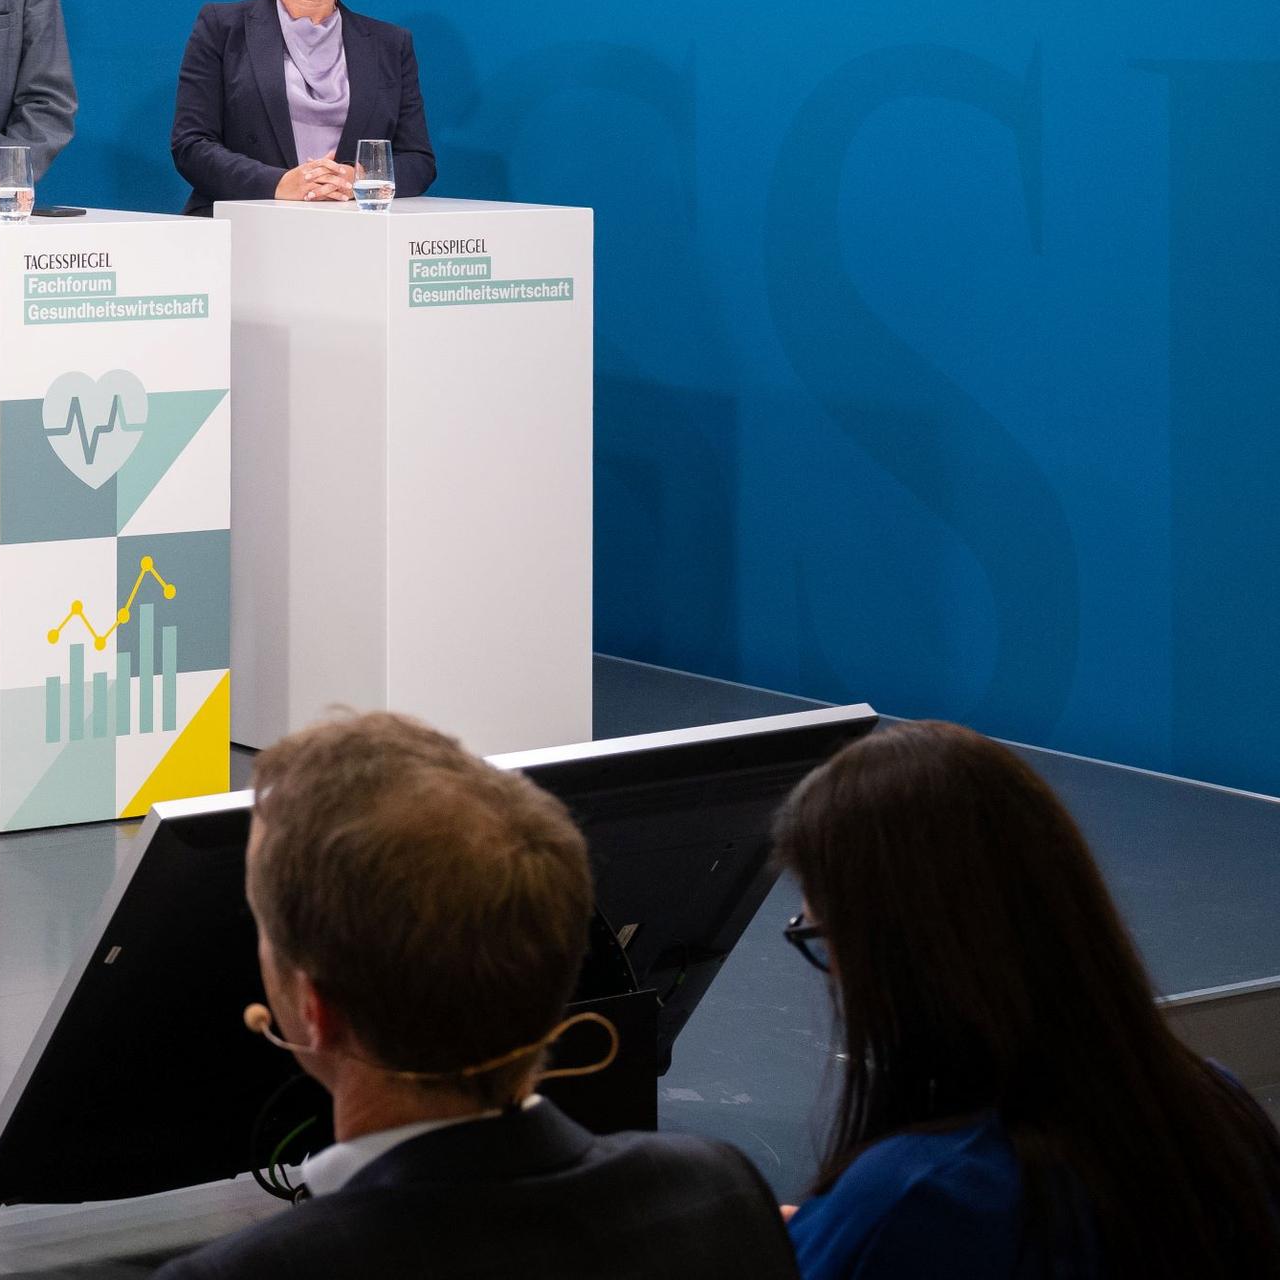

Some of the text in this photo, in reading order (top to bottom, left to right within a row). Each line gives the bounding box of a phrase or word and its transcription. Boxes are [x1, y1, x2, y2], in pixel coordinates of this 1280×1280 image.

[409, 238, 487, 255] TAGESSPIEGEL
[24, 253, 112, 270] TAGESSPIEGEL
[413, 262, 487, 278] Fachforum
[28, 277, 112, 294] Fachforum
[413, 283, 570, 303] Gesundheitswirtschaft
[28, 298, 204, 320] Gesundheitswirtschaft
